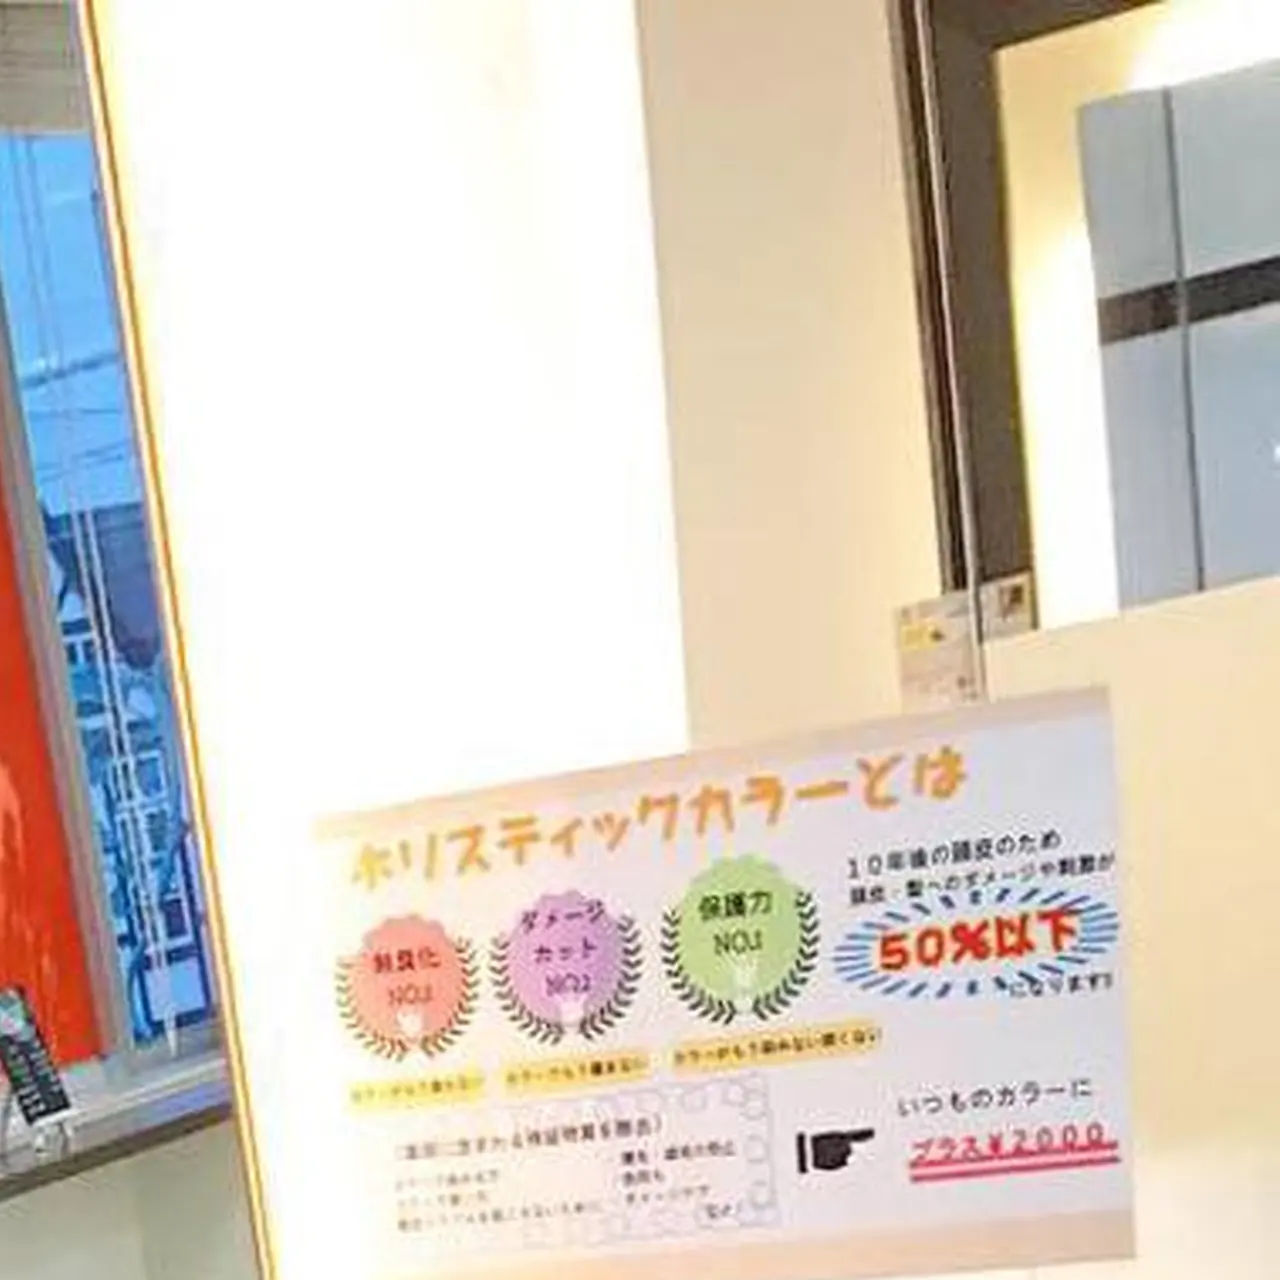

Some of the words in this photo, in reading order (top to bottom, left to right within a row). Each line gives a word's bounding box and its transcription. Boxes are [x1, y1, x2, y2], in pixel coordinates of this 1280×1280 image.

[352, 744, 967, 891] ホリスティックカラーとは
[877, 904, 1079, 973] 50%以下
[898, 1079, 1092, 1118] いつものカラーに
